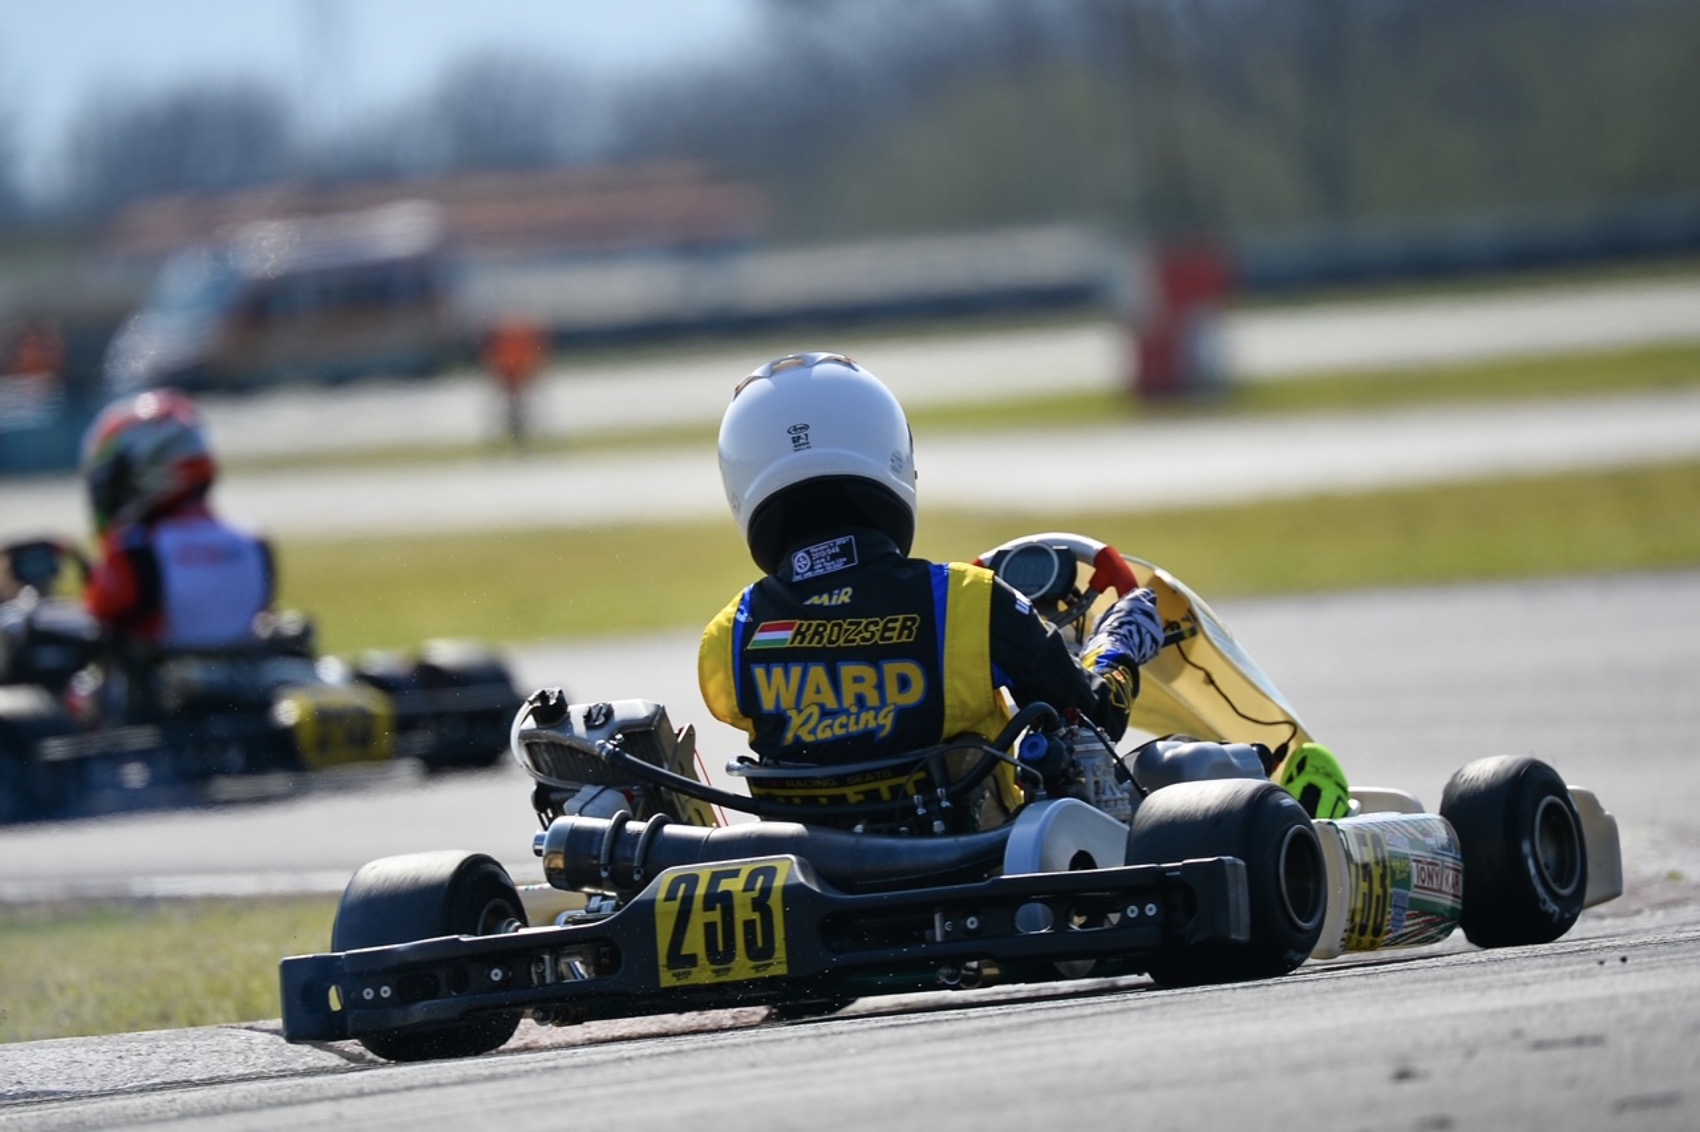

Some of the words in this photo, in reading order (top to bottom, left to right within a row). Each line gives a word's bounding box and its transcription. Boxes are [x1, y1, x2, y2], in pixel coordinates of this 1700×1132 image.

[789, 615, 920, 647] KROZSER
[752, 660, 927, 713] WARD
[782, 703, 895, 746] Racing
[786, 777, 837, 787] RACING
[846, 771, 892, 785] SEATS
[663, 866, 778, 970] 253
